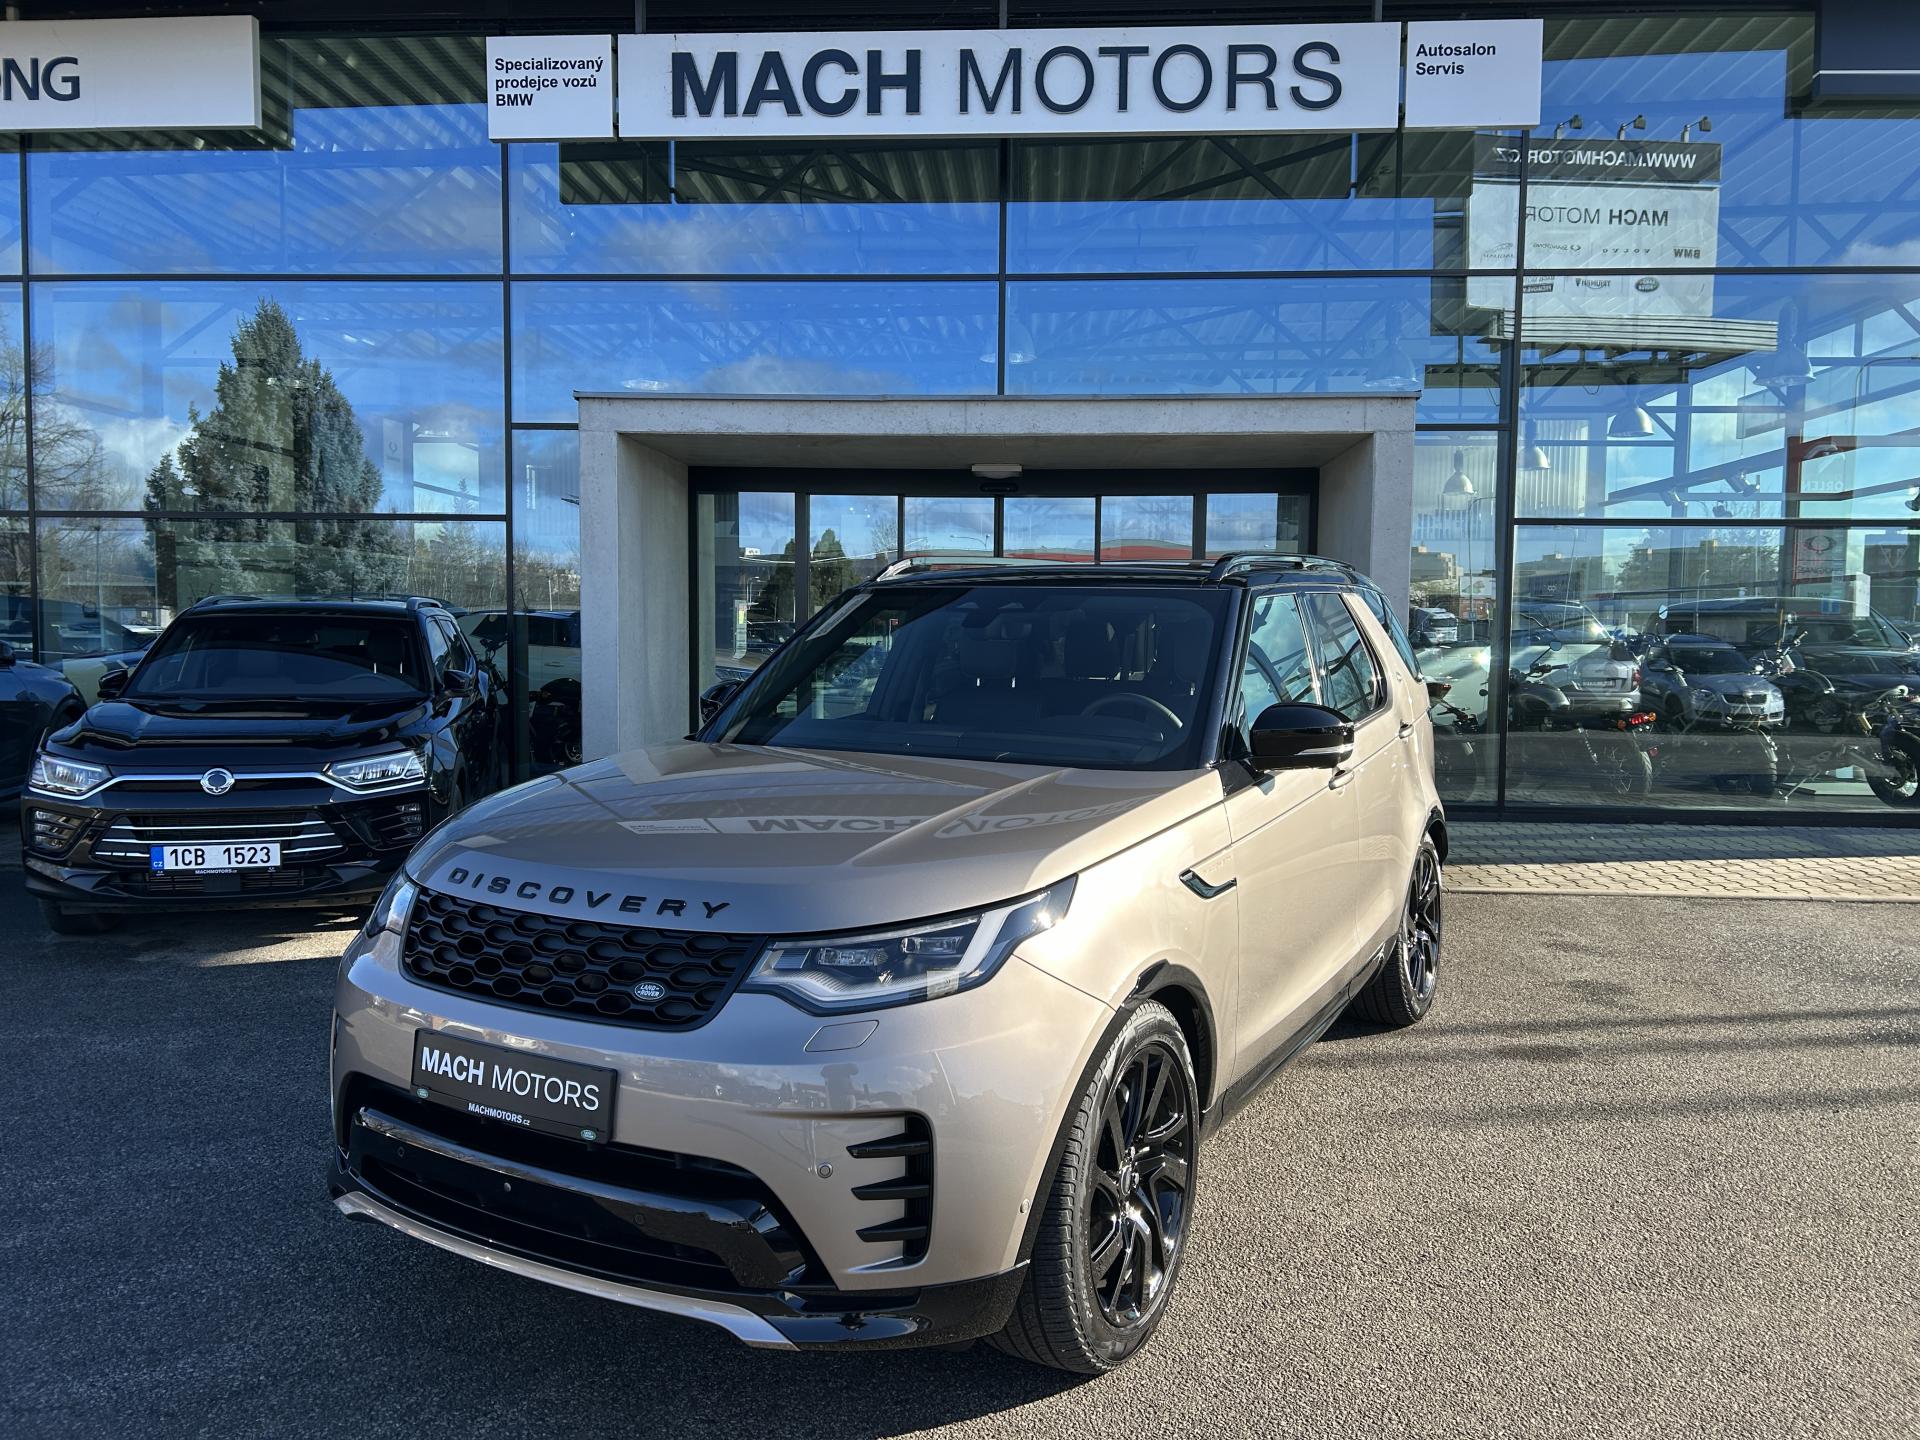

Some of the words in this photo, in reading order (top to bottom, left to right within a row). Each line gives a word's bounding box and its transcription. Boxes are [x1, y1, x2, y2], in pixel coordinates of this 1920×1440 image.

[1416, 43, 1496, 57] Autosalon
[494, 56, 604, 74] Specializovaný
[1416, 62, 1465, 76] Servis
[0, 56, 81, 102] NG
[495, 75, 559, 92] prodejce
[562, 72, 598, 88] vozů
[671, 49, 922, 118] MACH
[959, 41, 1344, 114] MOTORS
[495, 93, 534, 107] BMW
[170, 848, 206, 867] 1CB
[223, 846, 271, 865] 1523
[447, 867, 731, 919] DISCOVERY
[421, 1046, 485, 1086] MACH
[491, 1064, 600, 1112] MOTORS
